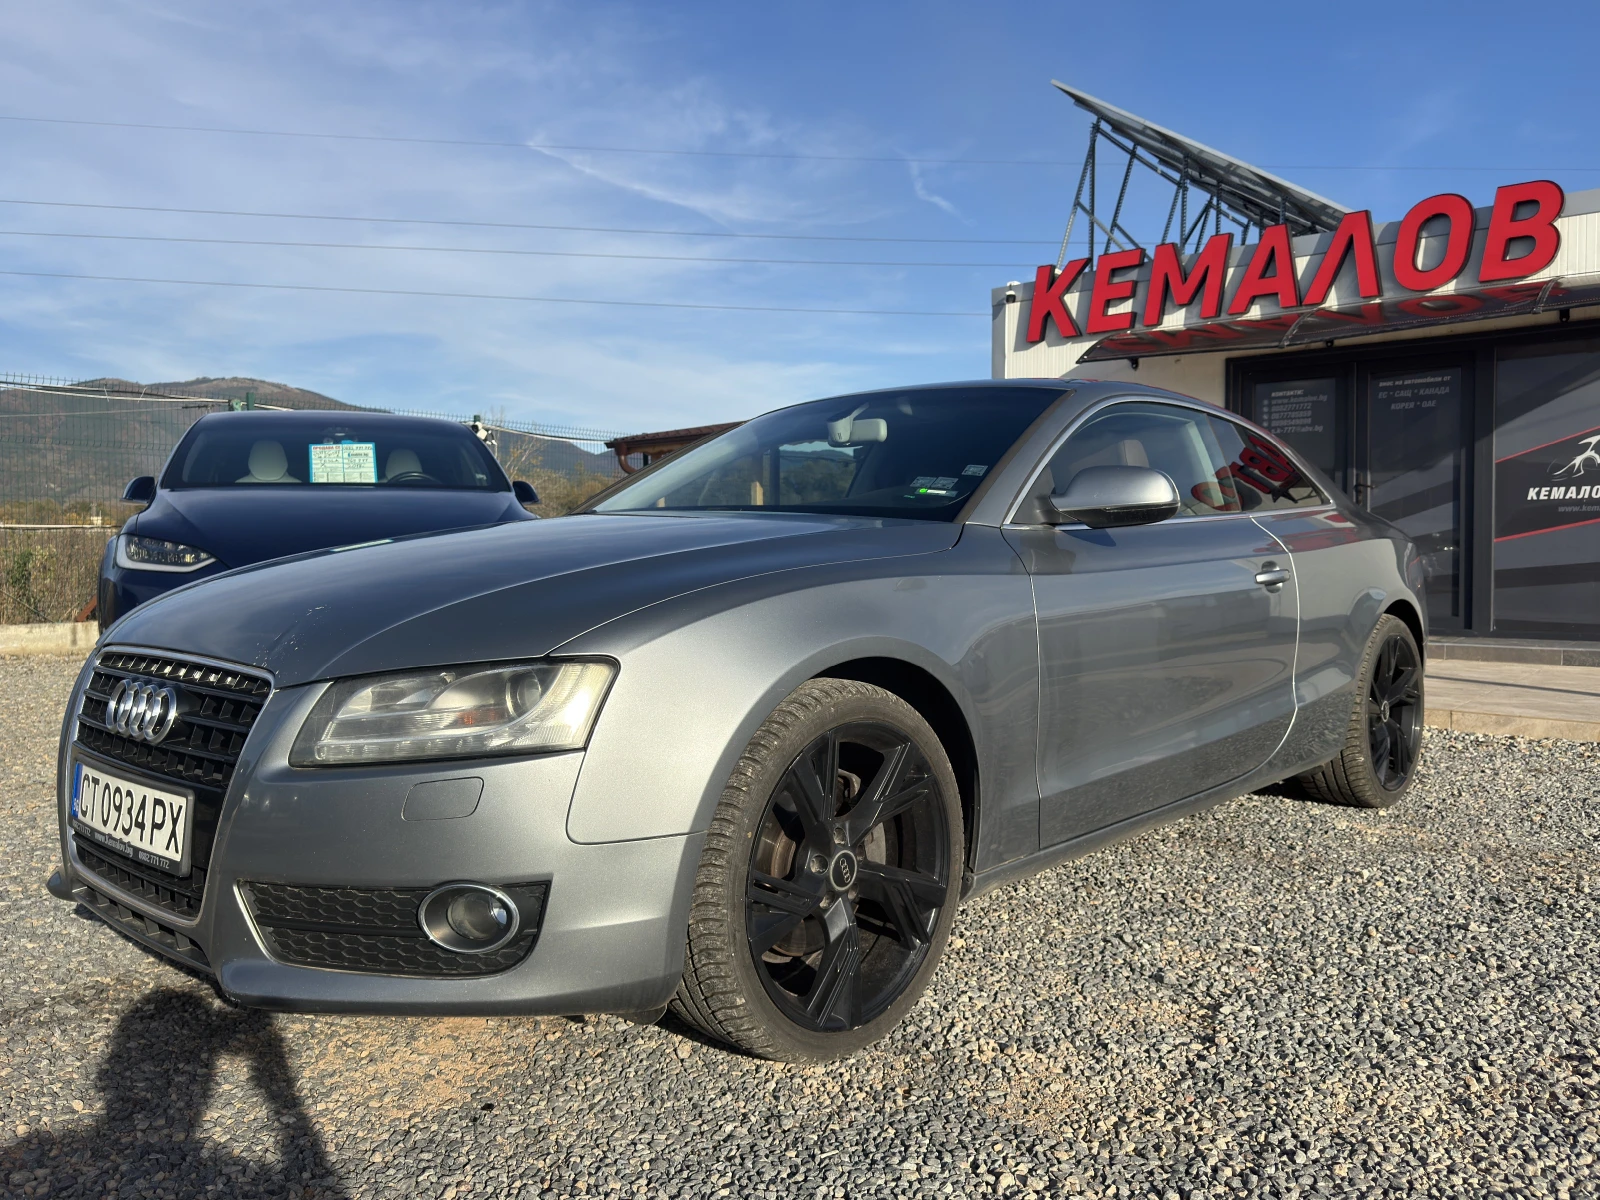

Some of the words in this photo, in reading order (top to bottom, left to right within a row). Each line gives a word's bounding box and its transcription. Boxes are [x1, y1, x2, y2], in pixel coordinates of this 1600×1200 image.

[1027, 179, 1565, 343] КЕМАЛОВ
[1395, 389, 1412, 398] САЩ
[1419, 386, 1450, 396] КАНАДА
[1391, 401, 1415, 411] КОРЕЯ
[1558, 504, 1600, 512] www.kem
